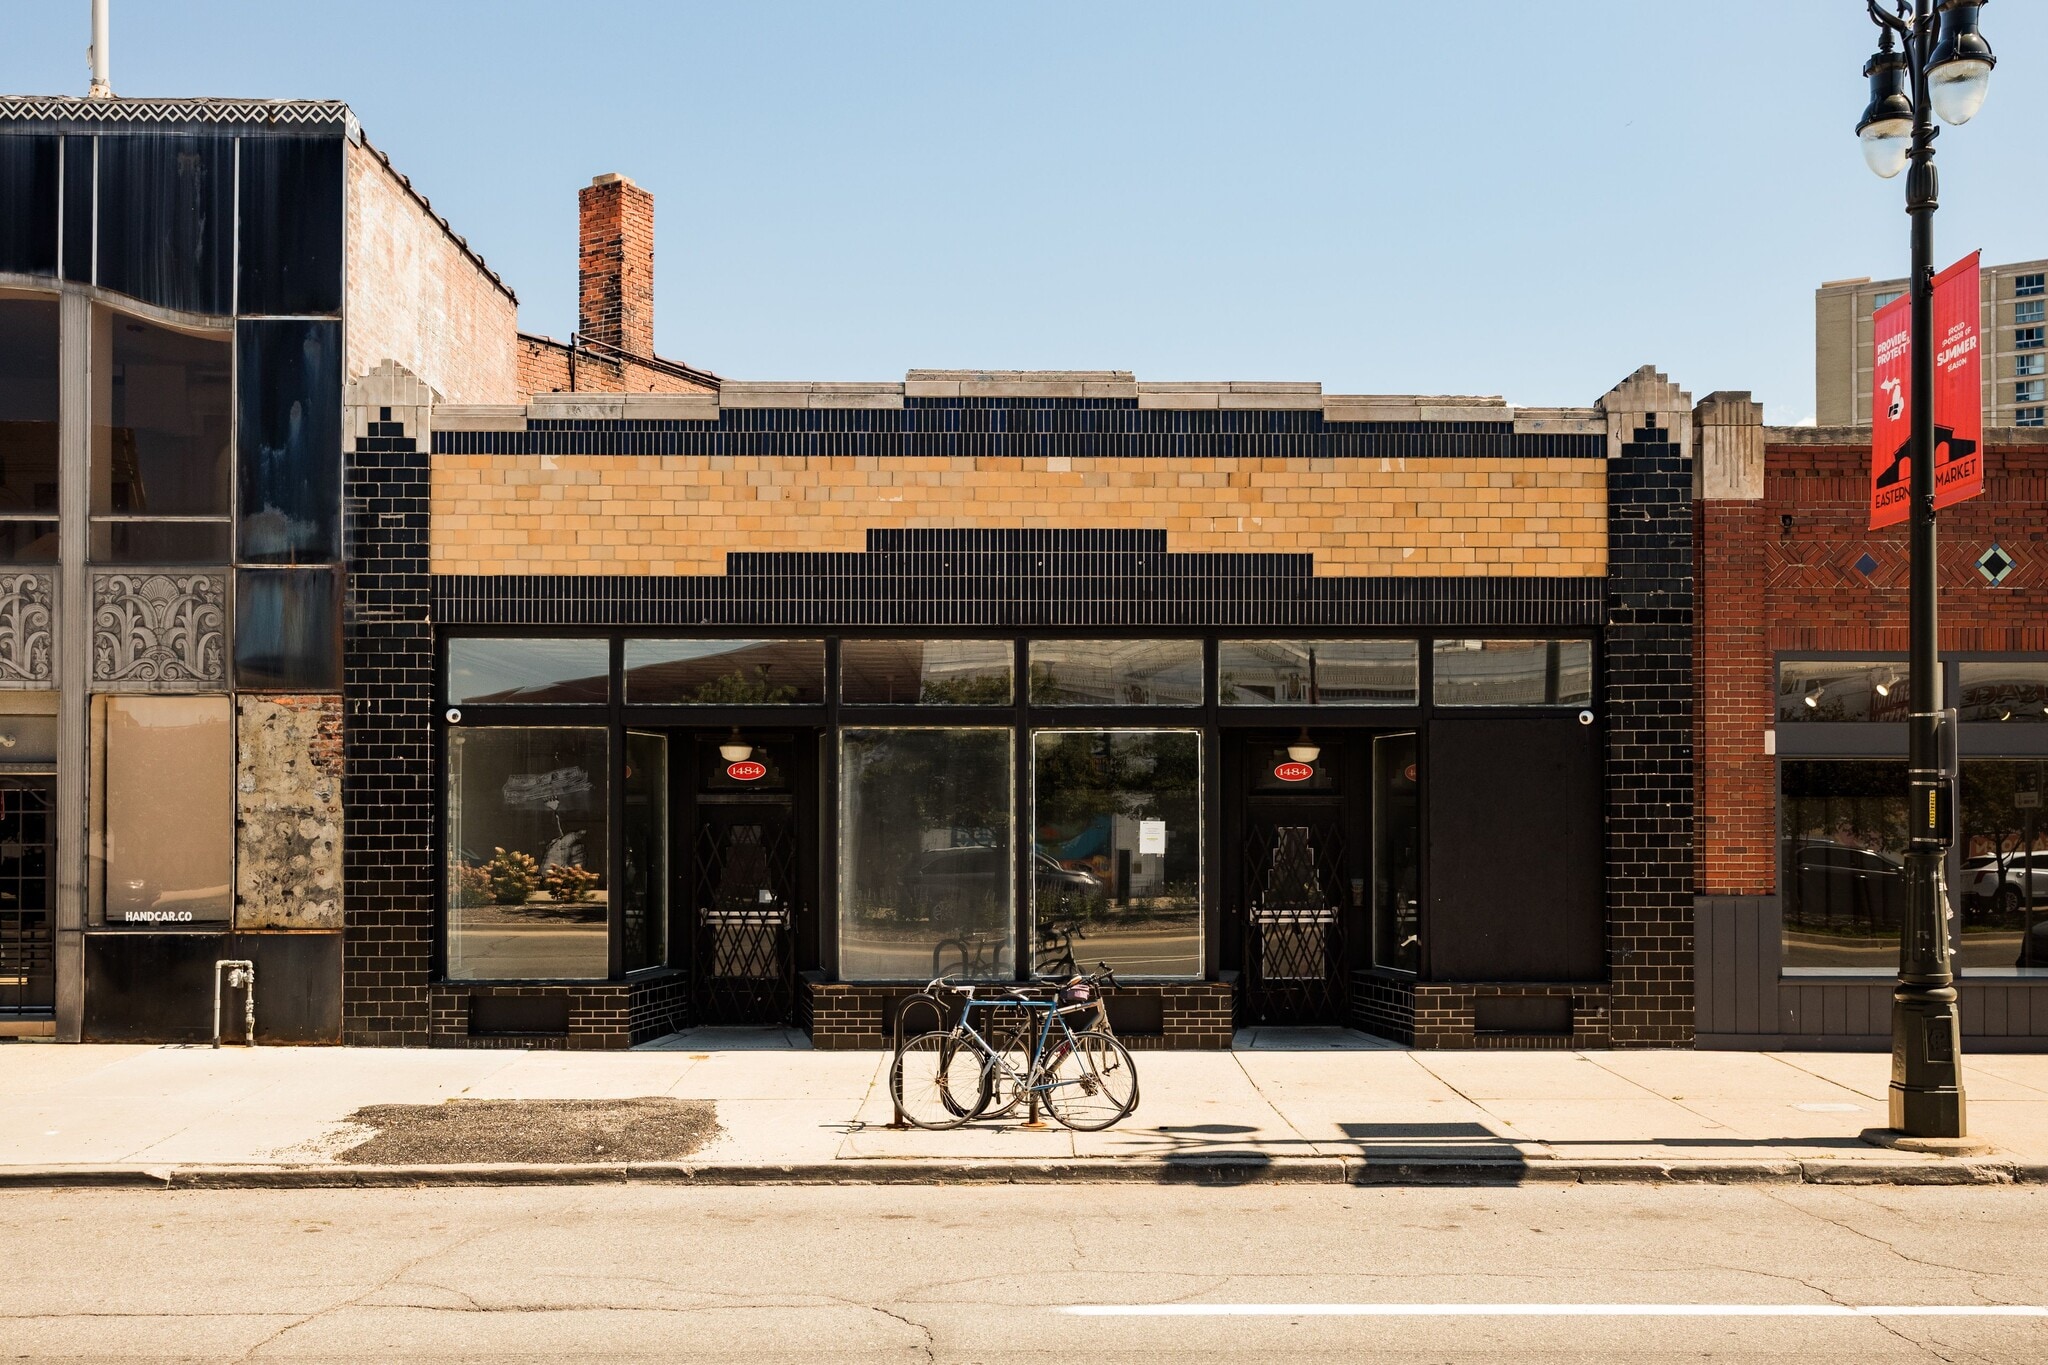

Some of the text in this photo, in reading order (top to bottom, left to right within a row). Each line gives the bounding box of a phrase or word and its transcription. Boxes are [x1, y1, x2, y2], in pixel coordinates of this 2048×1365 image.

[1941, 326, 1972, 348] SPONSOR OF
[1948, 321, 1965, 337] PROUD
[1877, 330, 1907, 356] PROVIDE
[1936, 335, 1977, 367] SUMMER
[1877, 342, 1907, 367] PROTECT
[1947, 357, 1967, 373] SEASON
[1875, 458, 1977, 509] EASTERN MARKET
[732, 766, 761, 775] 1484
[1279, 767, 1308, 776] 1484
[125, 911, 192, 922] HANDCAR.CO
